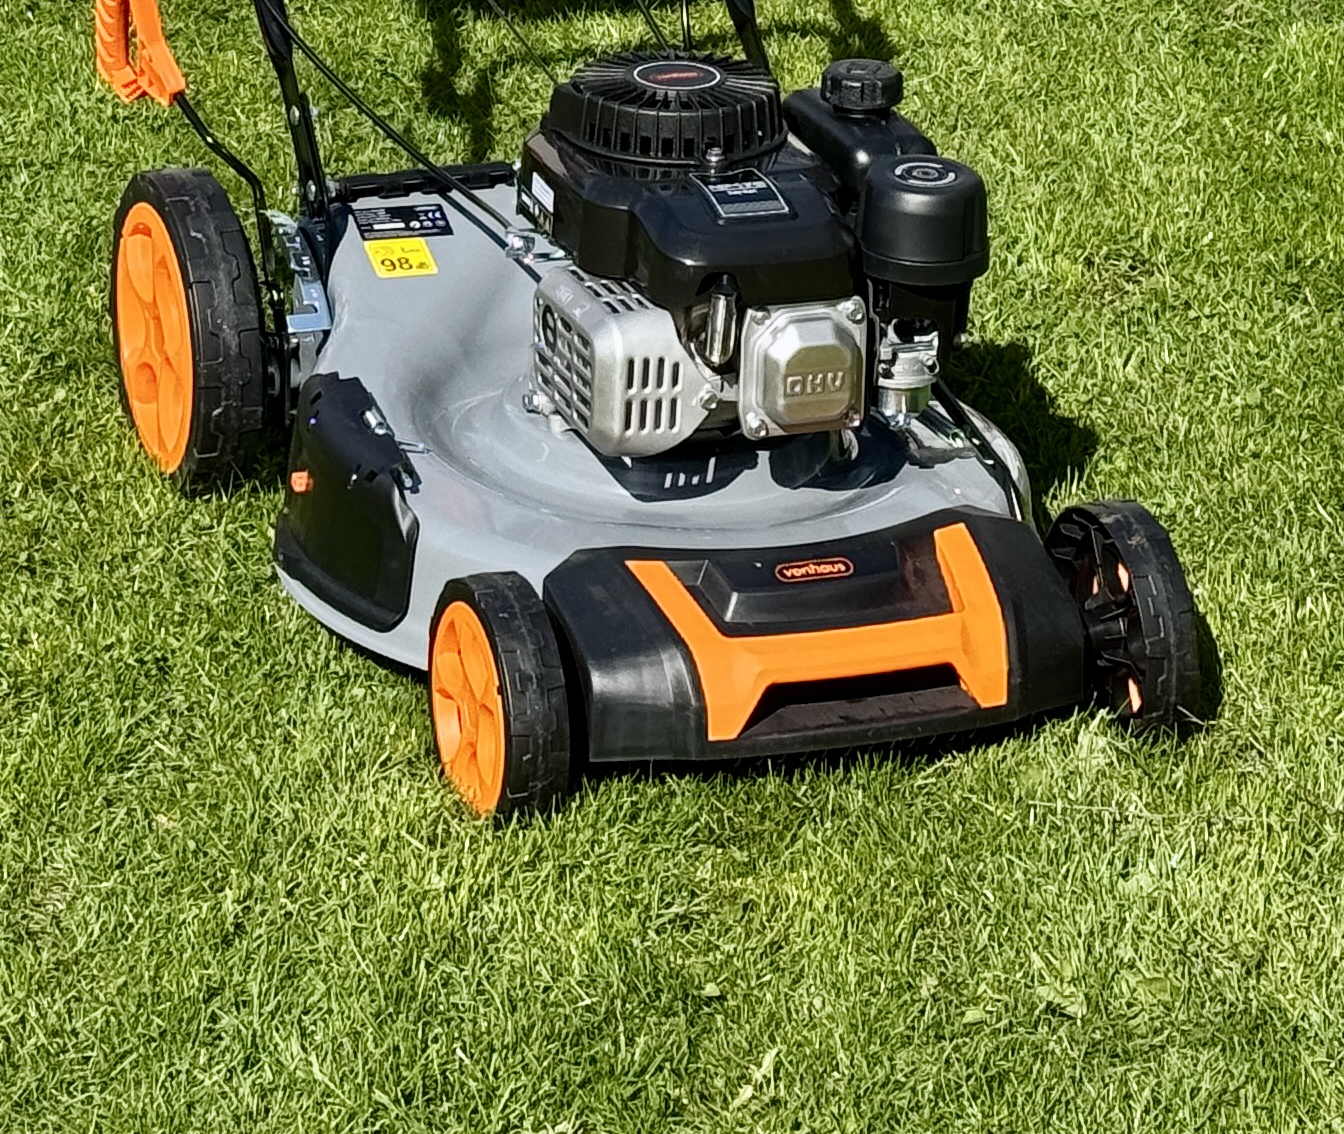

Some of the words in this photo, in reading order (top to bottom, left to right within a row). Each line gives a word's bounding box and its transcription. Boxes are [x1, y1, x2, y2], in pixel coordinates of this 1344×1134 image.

[380, 257, 413, 272] 98
[786, 371, 844, 395] OHV
[783, 563, 846, 577] vonhaus
